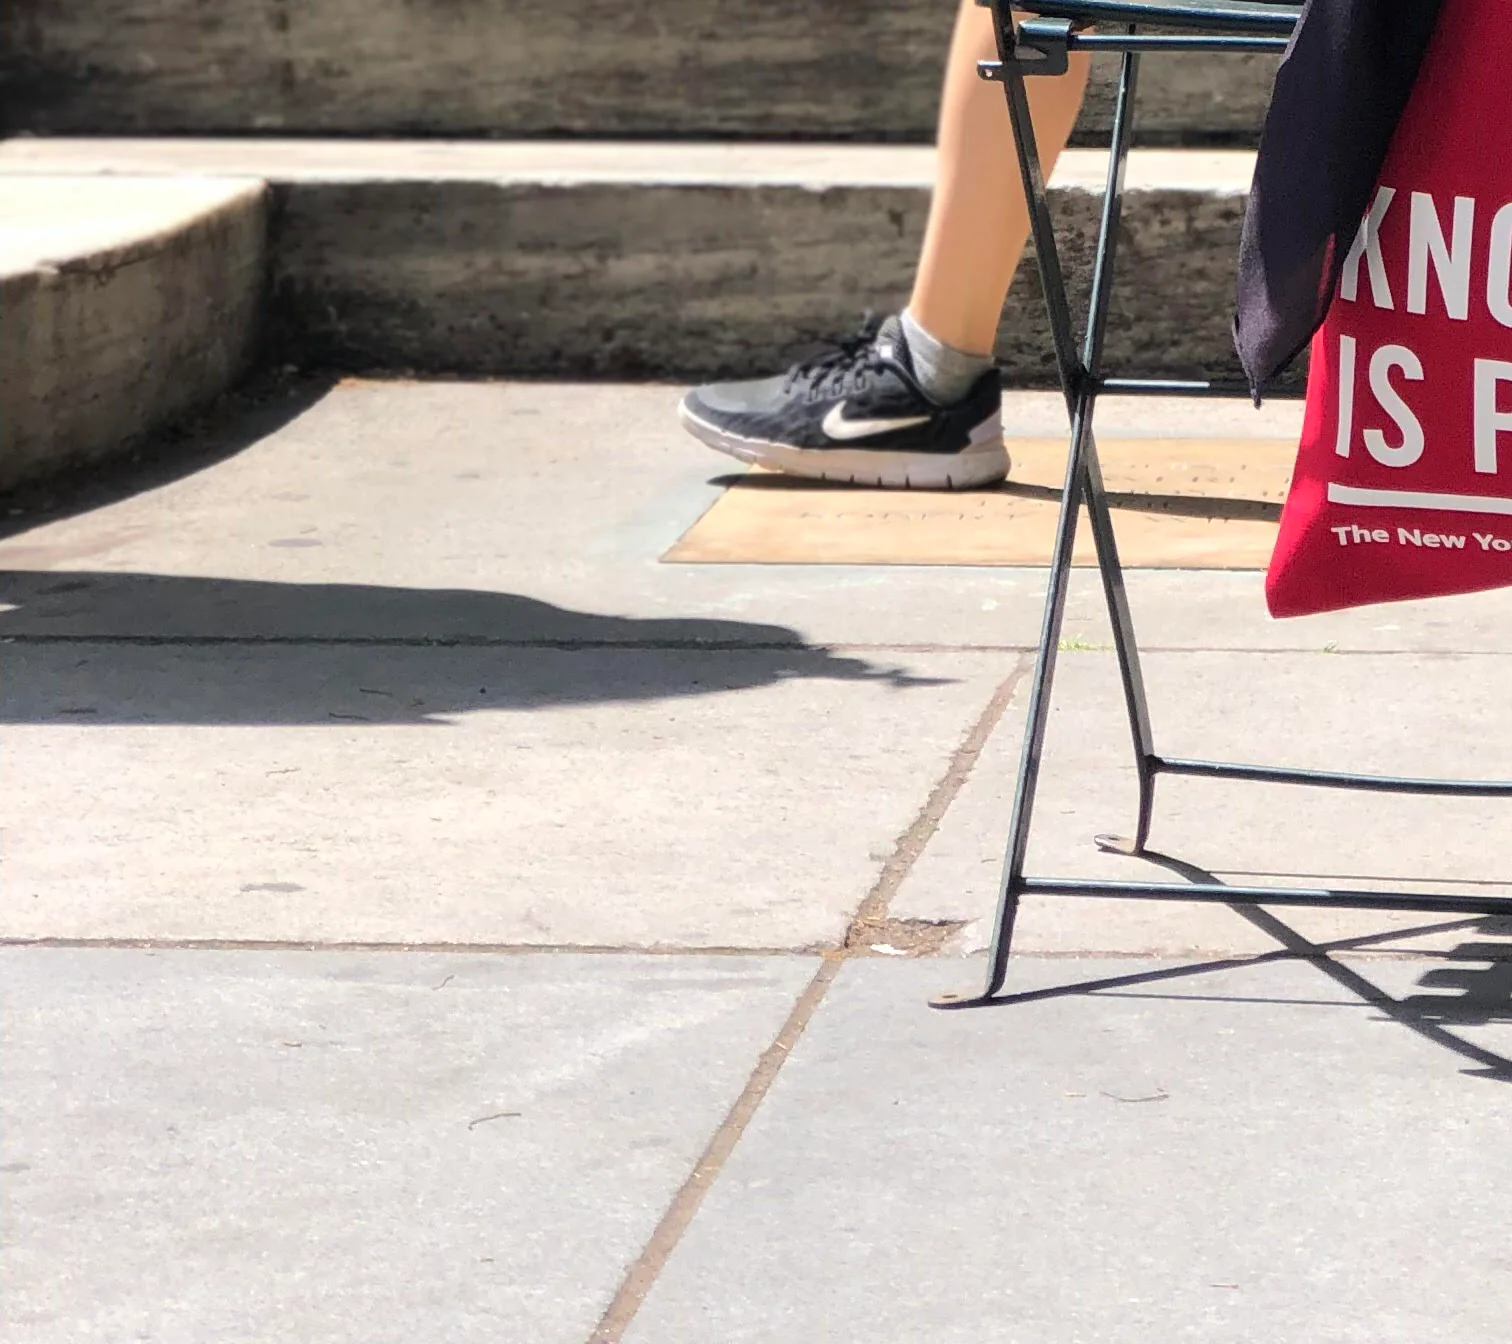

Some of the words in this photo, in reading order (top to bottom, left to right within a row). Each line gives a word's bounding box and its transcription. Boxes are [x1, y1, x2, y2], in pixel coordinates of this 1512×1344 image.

[1335, 334, 1425, 468] IS
[1330, 525, 1391, 546] The
[1397, 527, 1466, 550] New
